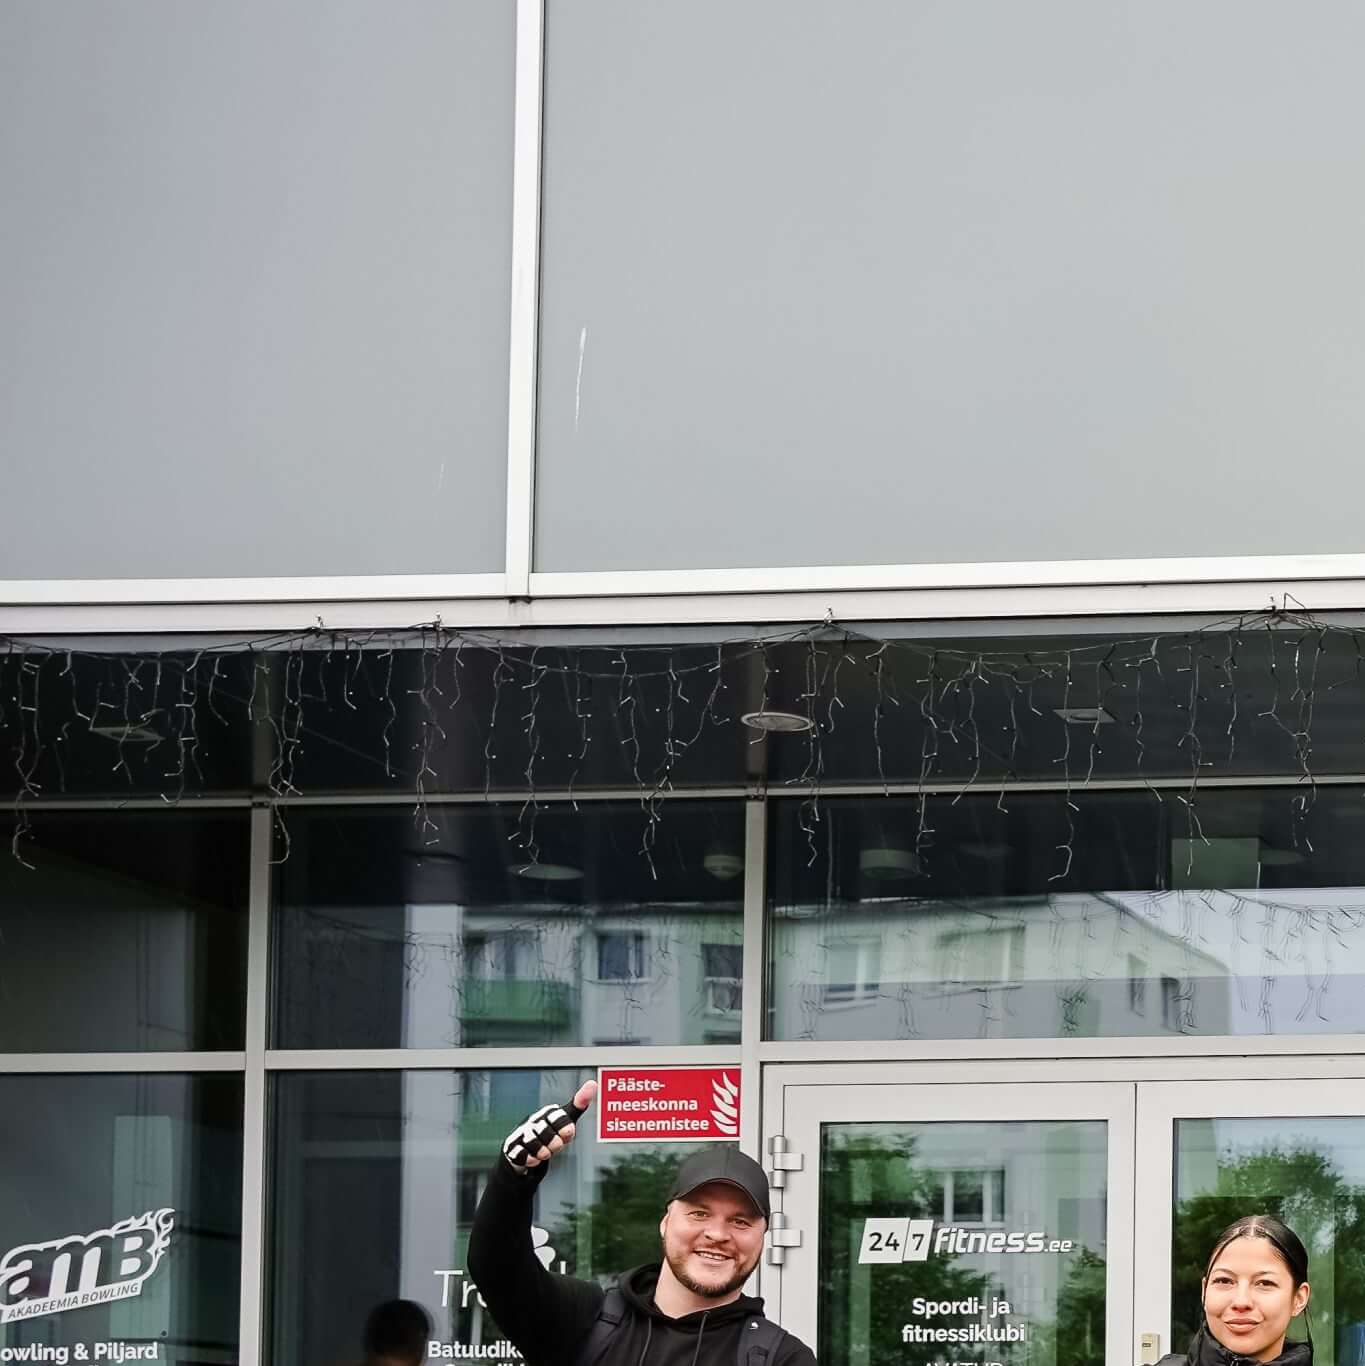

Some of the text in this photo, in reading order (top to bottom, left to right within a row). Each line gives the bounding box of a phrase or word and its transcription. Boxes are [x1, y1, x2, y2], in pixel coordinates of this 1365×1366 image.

[607, 1078, 665, 1091] Pääste-
[607, 1097, 698, 1112] meeskonna
[606, 1117, 709, 1132] sisenemistee
[8, 1283, 139, 1319] AKADEEMIA BOWLING
[912, 1297, 1010, 1318] Spordi- ja
[902, 1324, 1025, 1342] fitnessiklubi
[73, 1343, 89, 1360] &
[94, 1342, 158, 1364] Piljard
[427, 1340, 523, 1359] Batuudik
